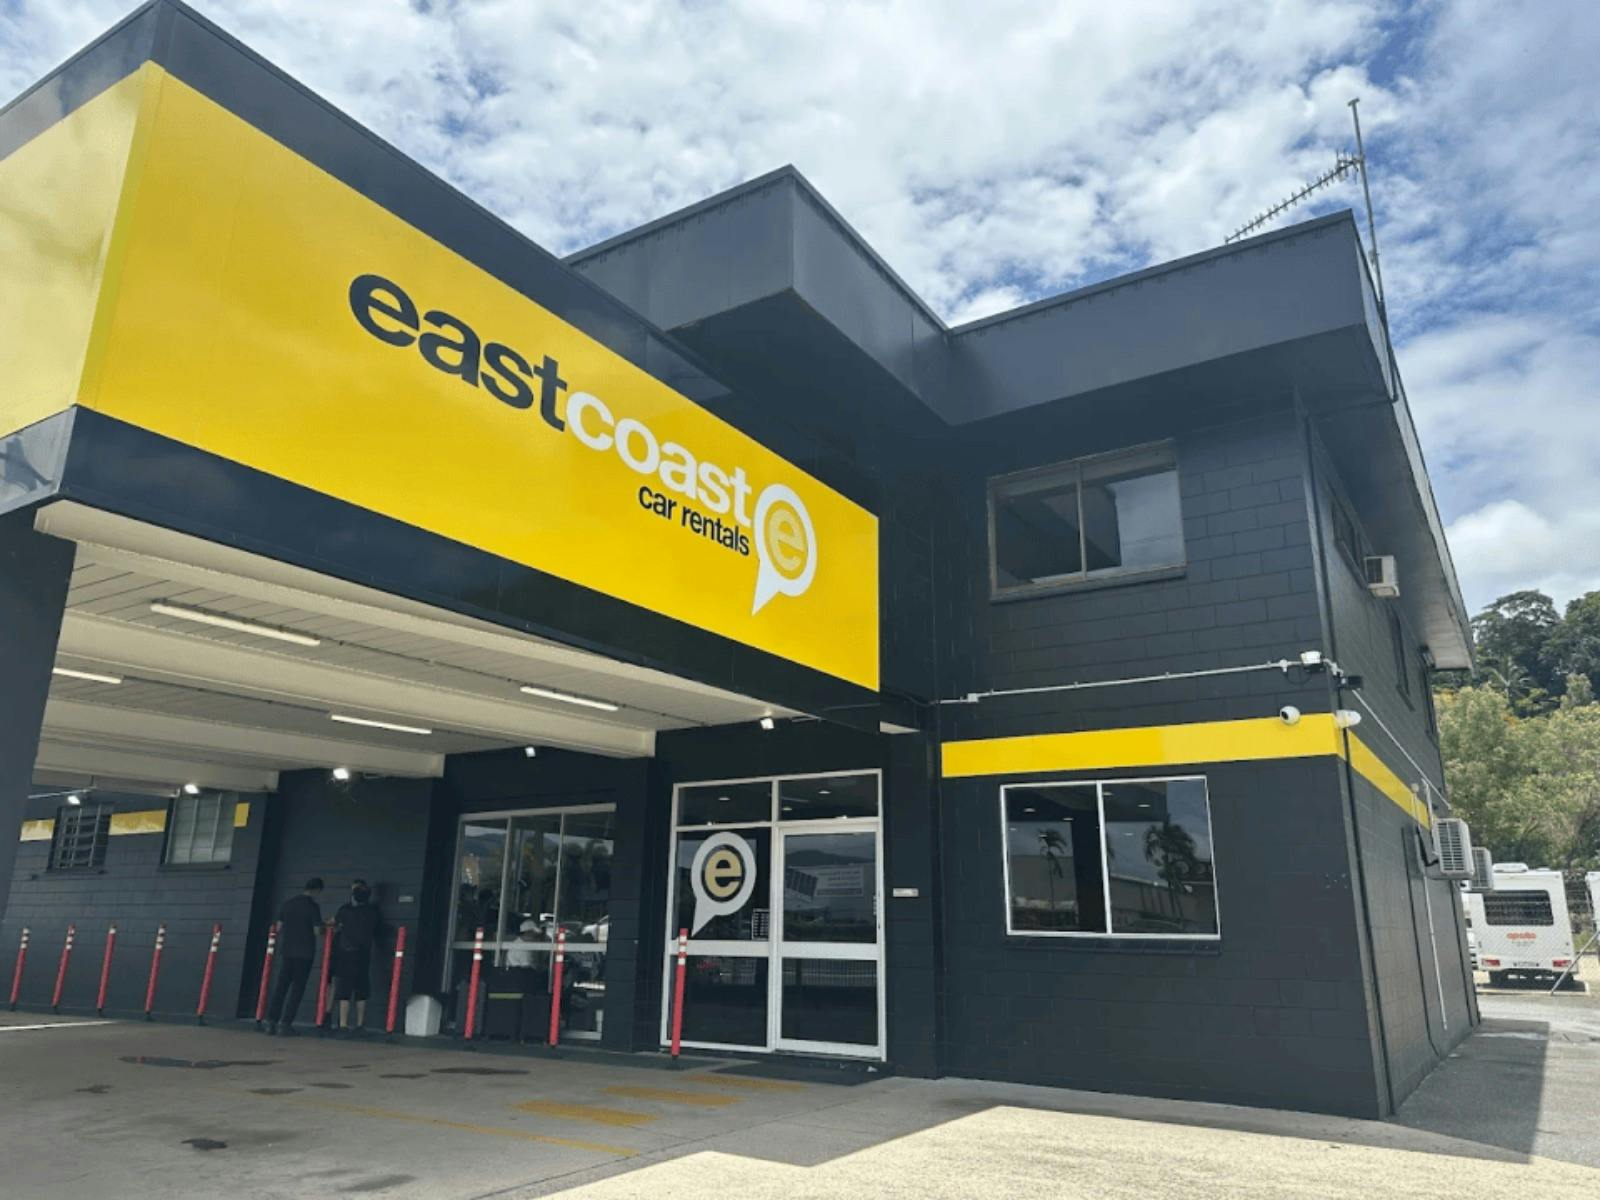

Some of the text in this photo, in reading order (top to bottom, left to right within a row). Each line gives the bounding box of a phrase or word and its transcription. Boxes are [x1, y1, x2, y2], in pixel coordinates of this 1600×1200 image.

[638, 486, 750, 557] car rentals
[768, 509, 805, 571] e
[704, 849, 743, 898] e
